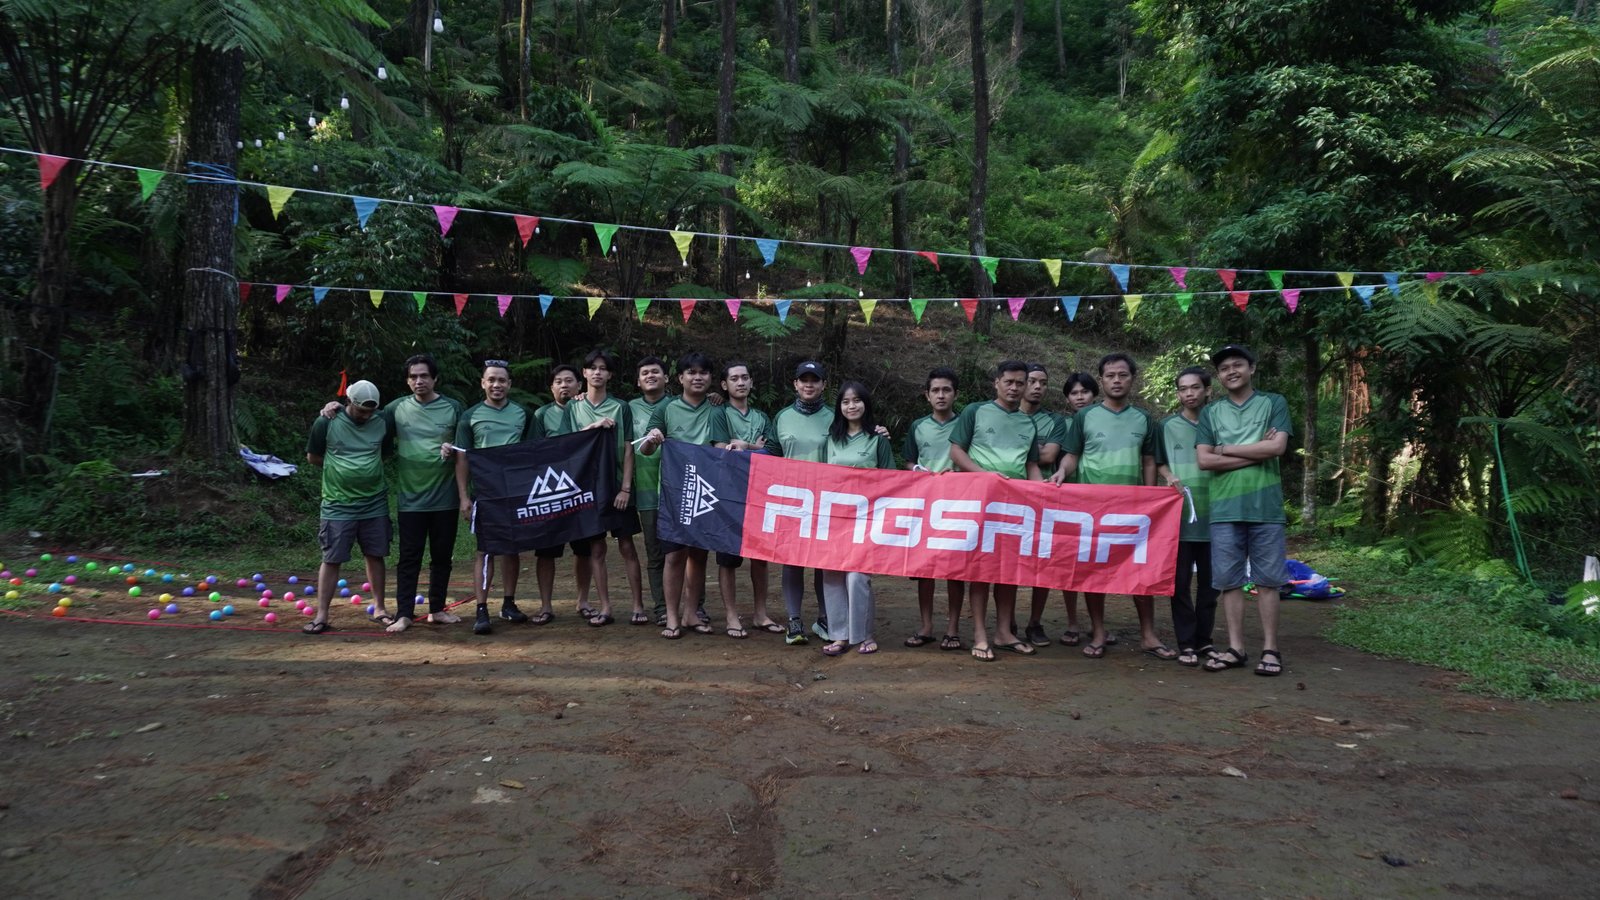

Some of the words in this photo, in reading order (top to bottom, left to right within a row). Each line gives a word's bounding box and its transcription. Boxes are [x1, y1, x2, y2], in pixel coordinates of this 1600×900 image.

[516, 491, 594, 519] ANGSANA
[683, 464, 697, 525] ANGSANA
[762, 484, 1152, 564] ANGSANA
